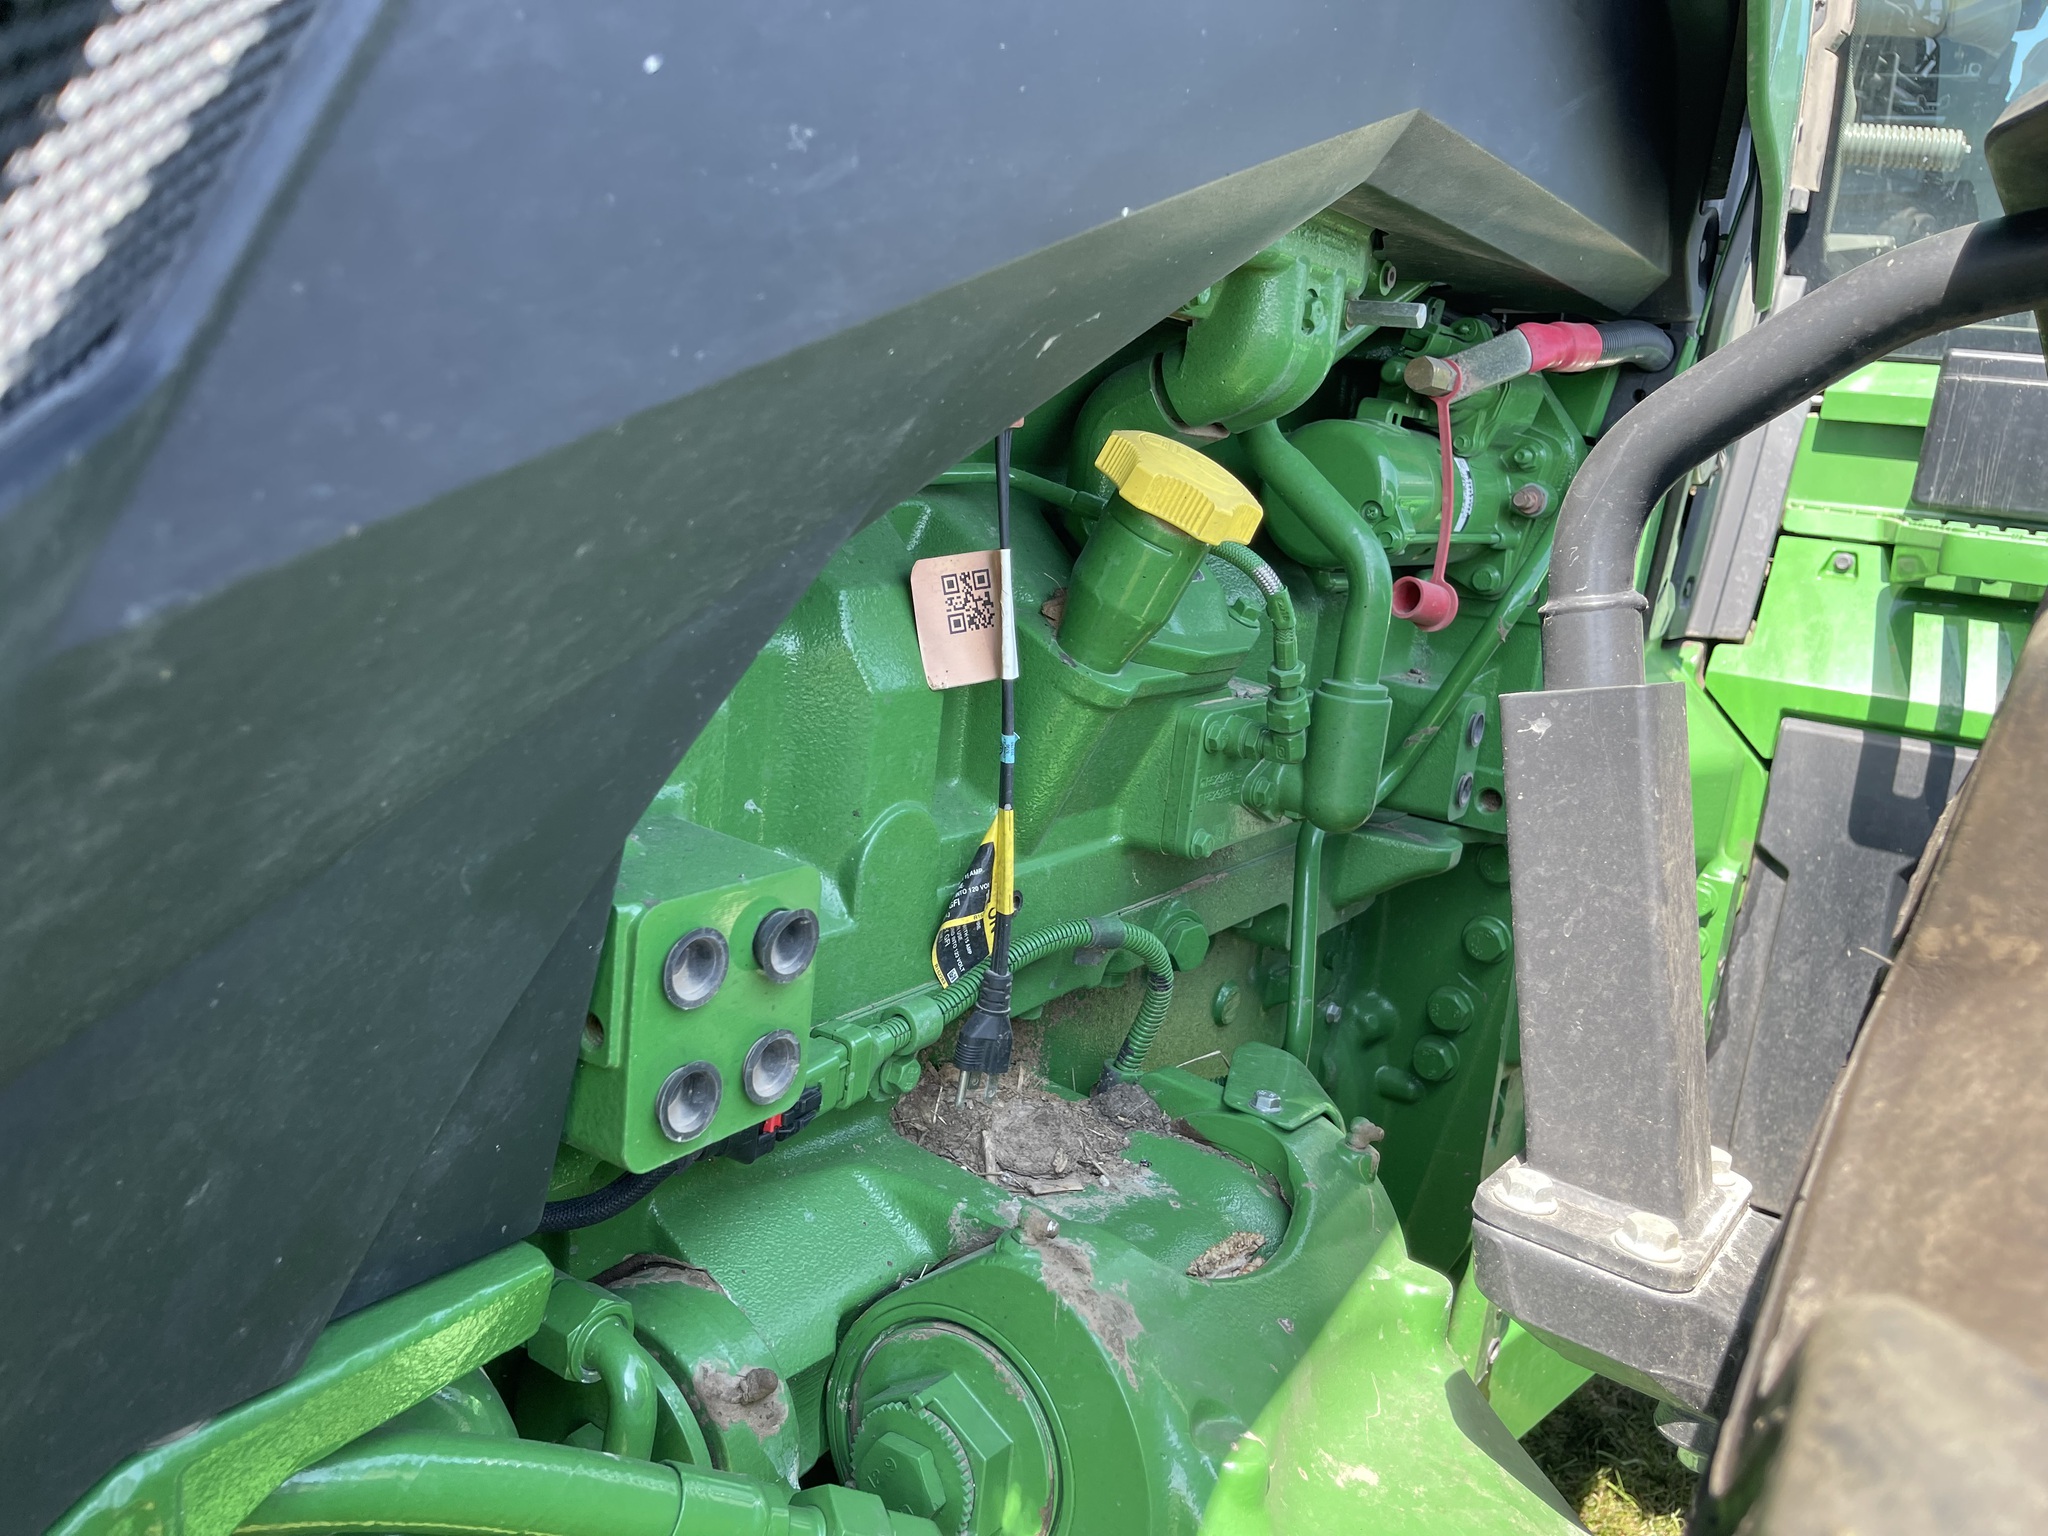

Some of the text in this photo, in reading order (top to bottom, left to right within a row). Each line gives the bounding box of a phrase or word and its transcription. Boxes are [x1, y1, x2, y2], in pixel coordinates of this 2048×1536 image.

[969, 868, 982, 877] AMP
[968, 885, 978, 893] 120
[956, 957, 965, 972] VOLT
